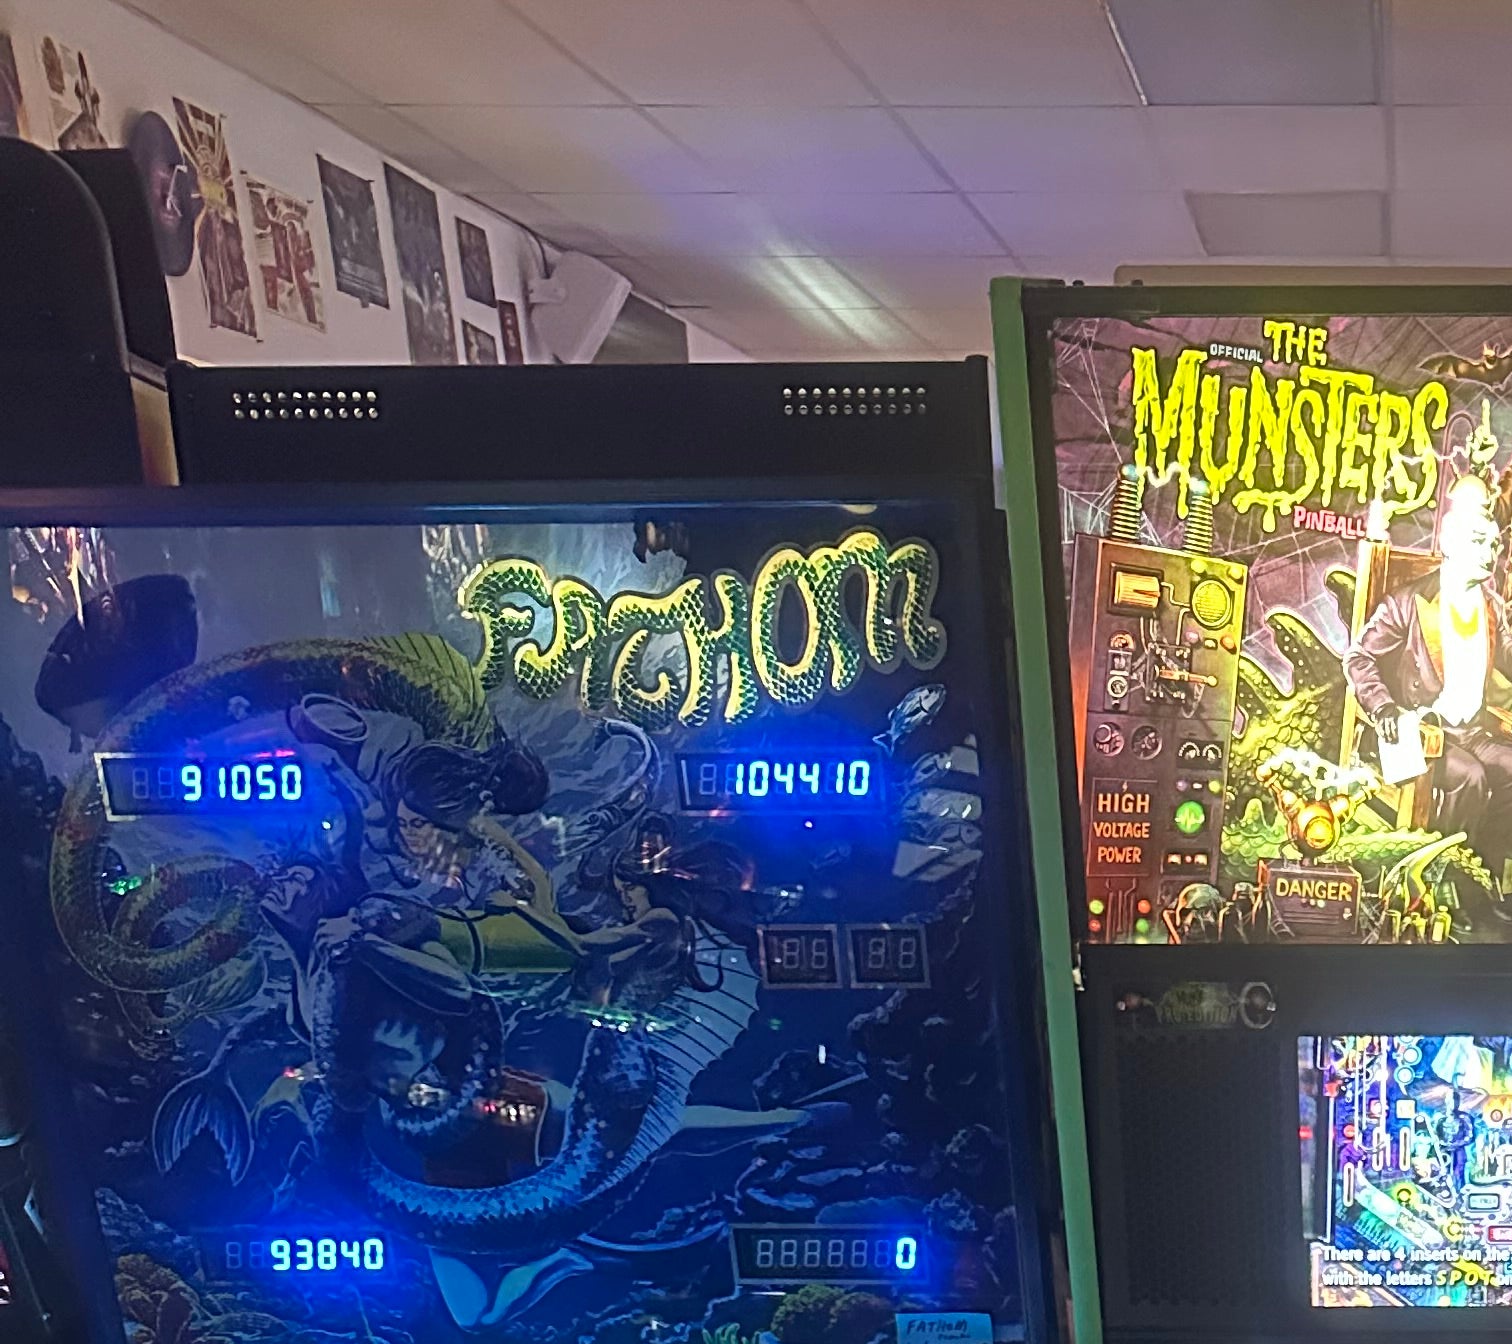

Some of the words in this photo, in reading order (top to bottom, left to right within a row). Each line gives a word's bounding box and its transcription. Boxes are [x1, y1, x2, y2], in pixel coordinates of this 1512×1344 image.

[1209, 343, 1263, 363] OFFICIAL
[1264, 320, 1327, 365] THE
[1132, 347, 1448, 532] MUNSTERS
[1294, 505, 1367, 539] PINBALL
[458, 531, 940, 728] FATHOM
[182, 765, 302, 802] 91050
[735, 760, 870, 797] 104410
[1098, 793, 1150, 814] HIGH
[1093, 822, 1151, 839] VOLTAGE
[1098, 846, 1142, 864] POWER
[1275, 877, 1353, 902] DANGER
[270, 1238, 384, 1271] 93840
[1323, 1247, 1363, 1262] There
[1366, 1250, 1391, 1262] are
[1394, 1248, 1406, 1262] 4
[1411, 1247, 1459, 1262] inserts
[1463, 1250, 1482, 1262] on
[1486, 1248, 1510, 1262] the
[1322, 1271, 1354, 1286] with
[1357, 1271, 1382, 1286] the
[1386, 1271, 1433, 1286] letters
